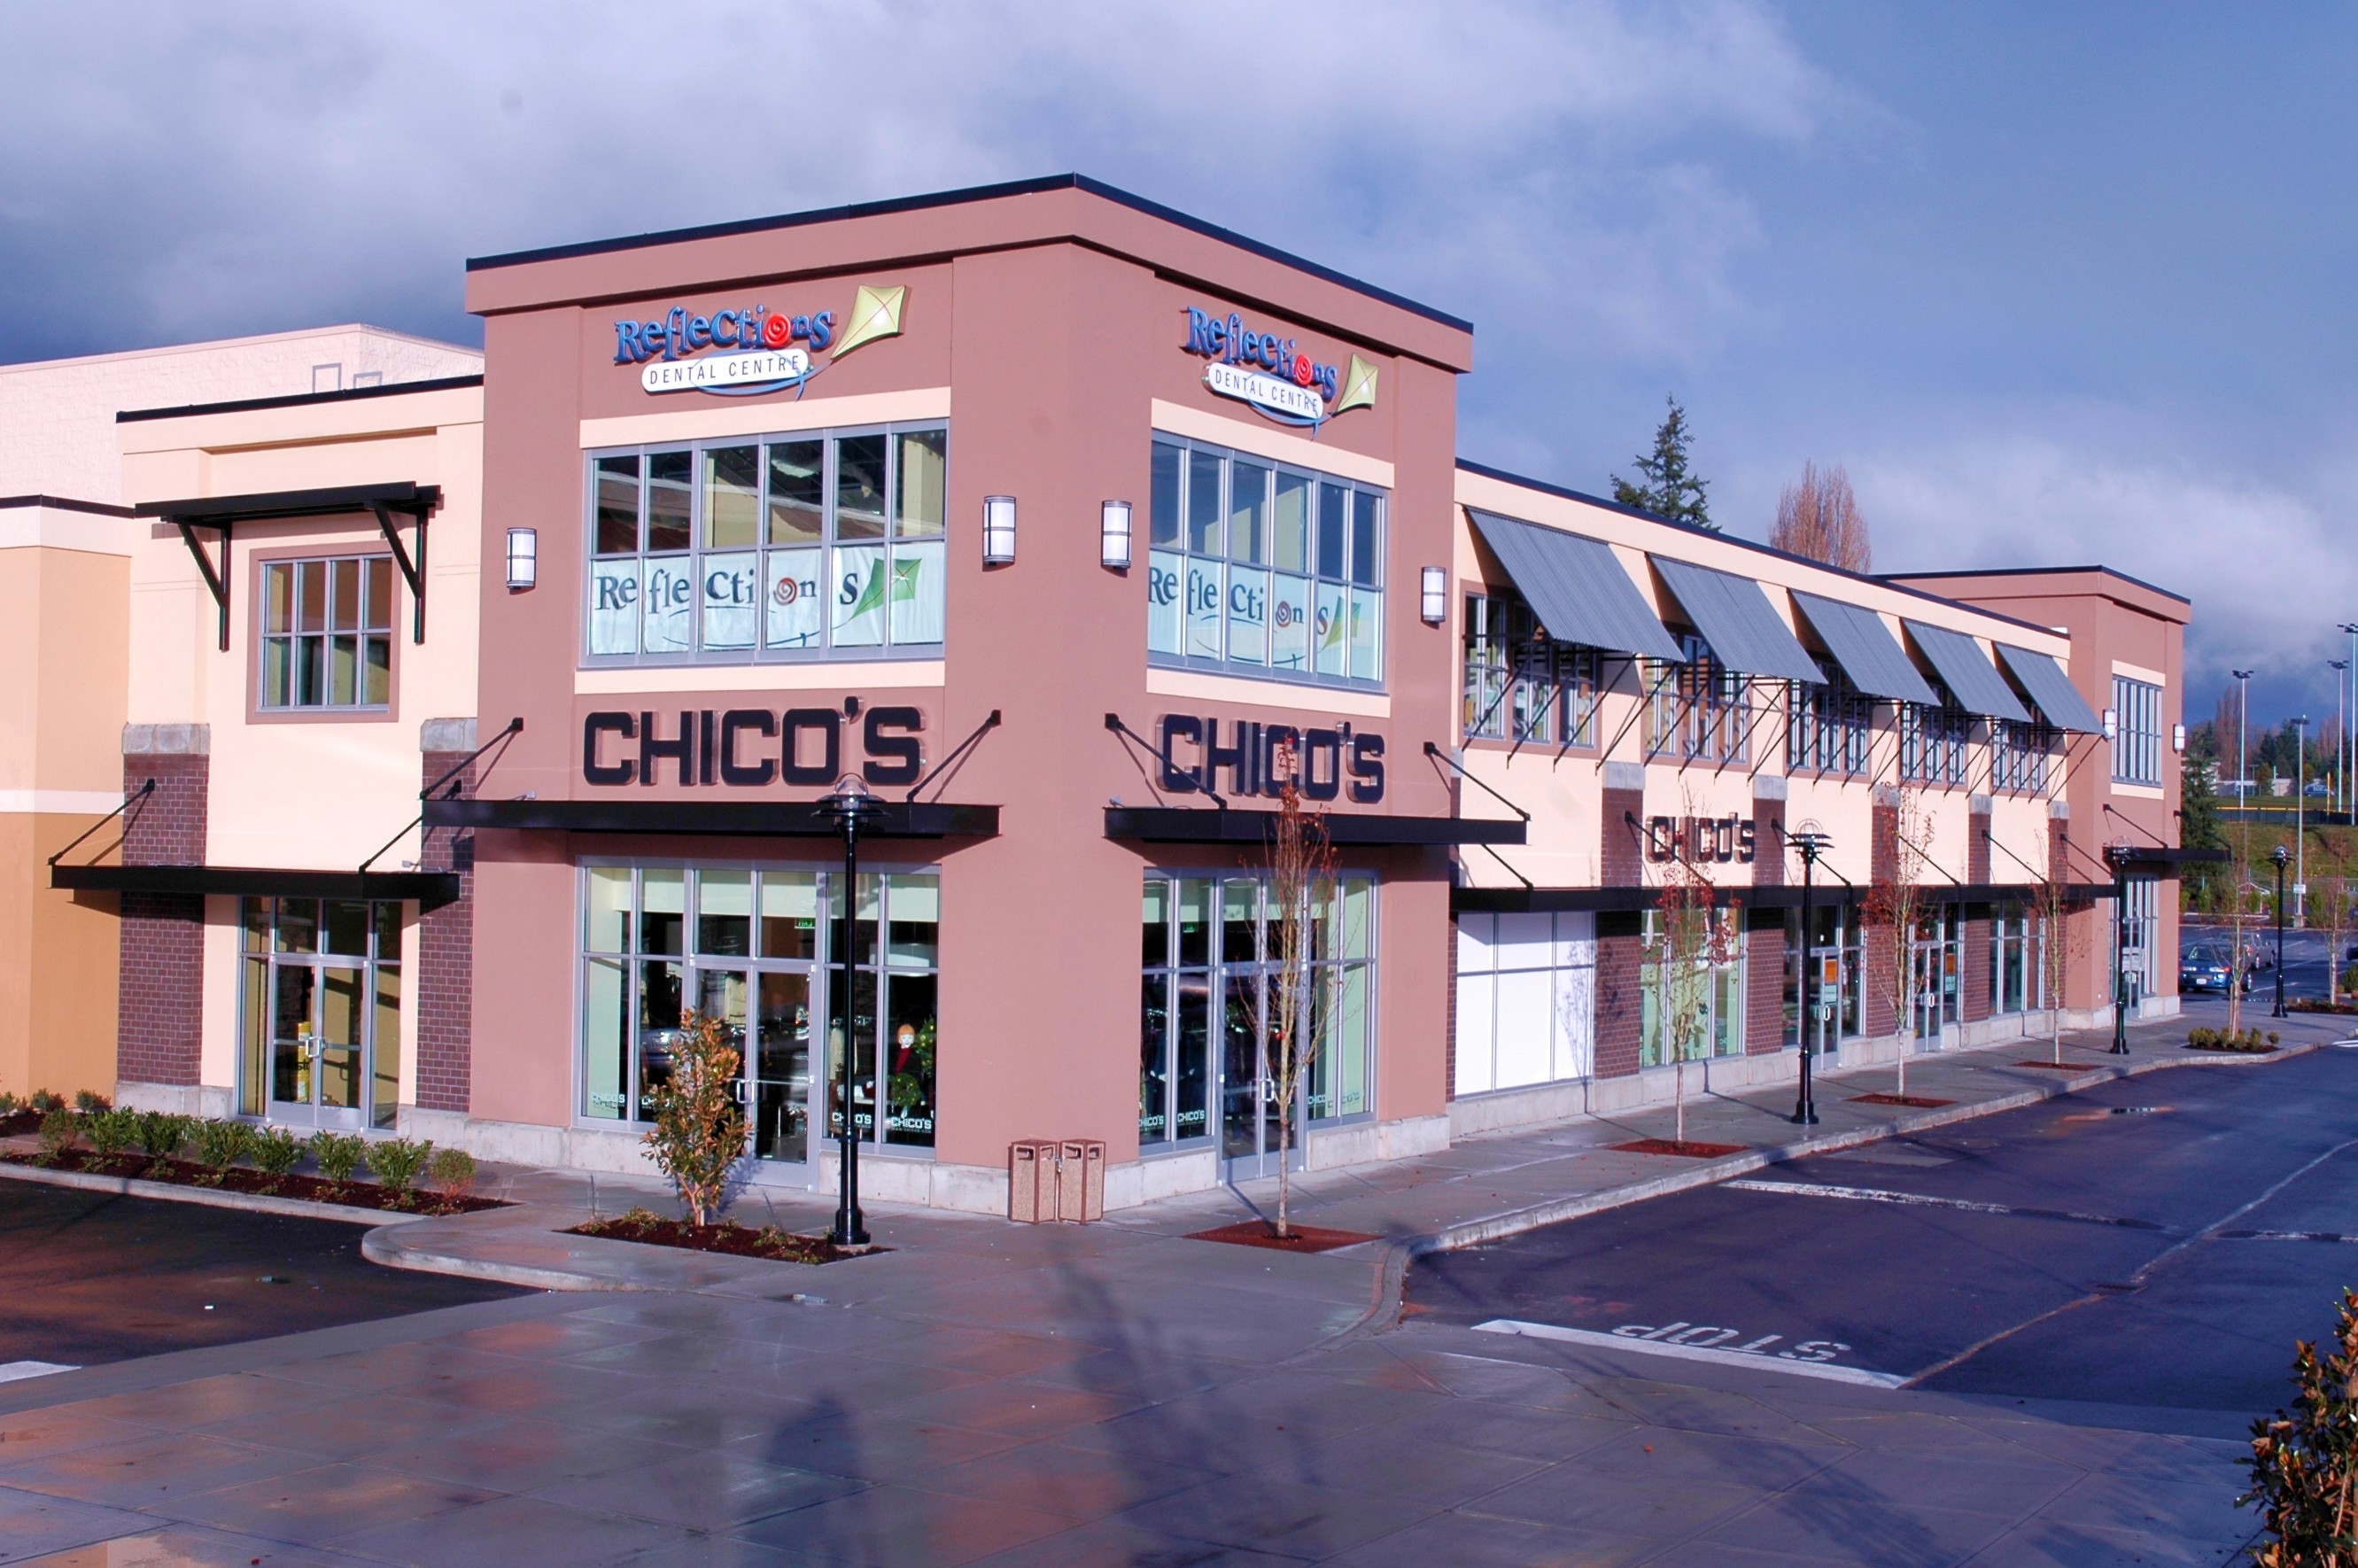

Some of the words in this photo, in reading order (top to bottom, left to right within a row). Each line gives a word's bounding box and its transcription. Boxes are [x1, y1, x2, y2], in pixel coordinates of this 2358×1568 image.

[648, 363, 717, 384] DENTAL
[728, 354, 800, 376] CENTRE
[1215, 369, 1264, 397] DENTAL
[1271, 385, 1318, 412] CENTRE
[583, 695, 924, 786] CHICO'S
[1156, 713, 1385, 803] CHICO'S
[1645, 812, 1755, 864] CHICO'S
[891, 1116, 932, 1129] CHICO'S
[1177, 1109, 1206, 1122] CHICO'S
[1611, 1322, 1851, 1362] STOP
